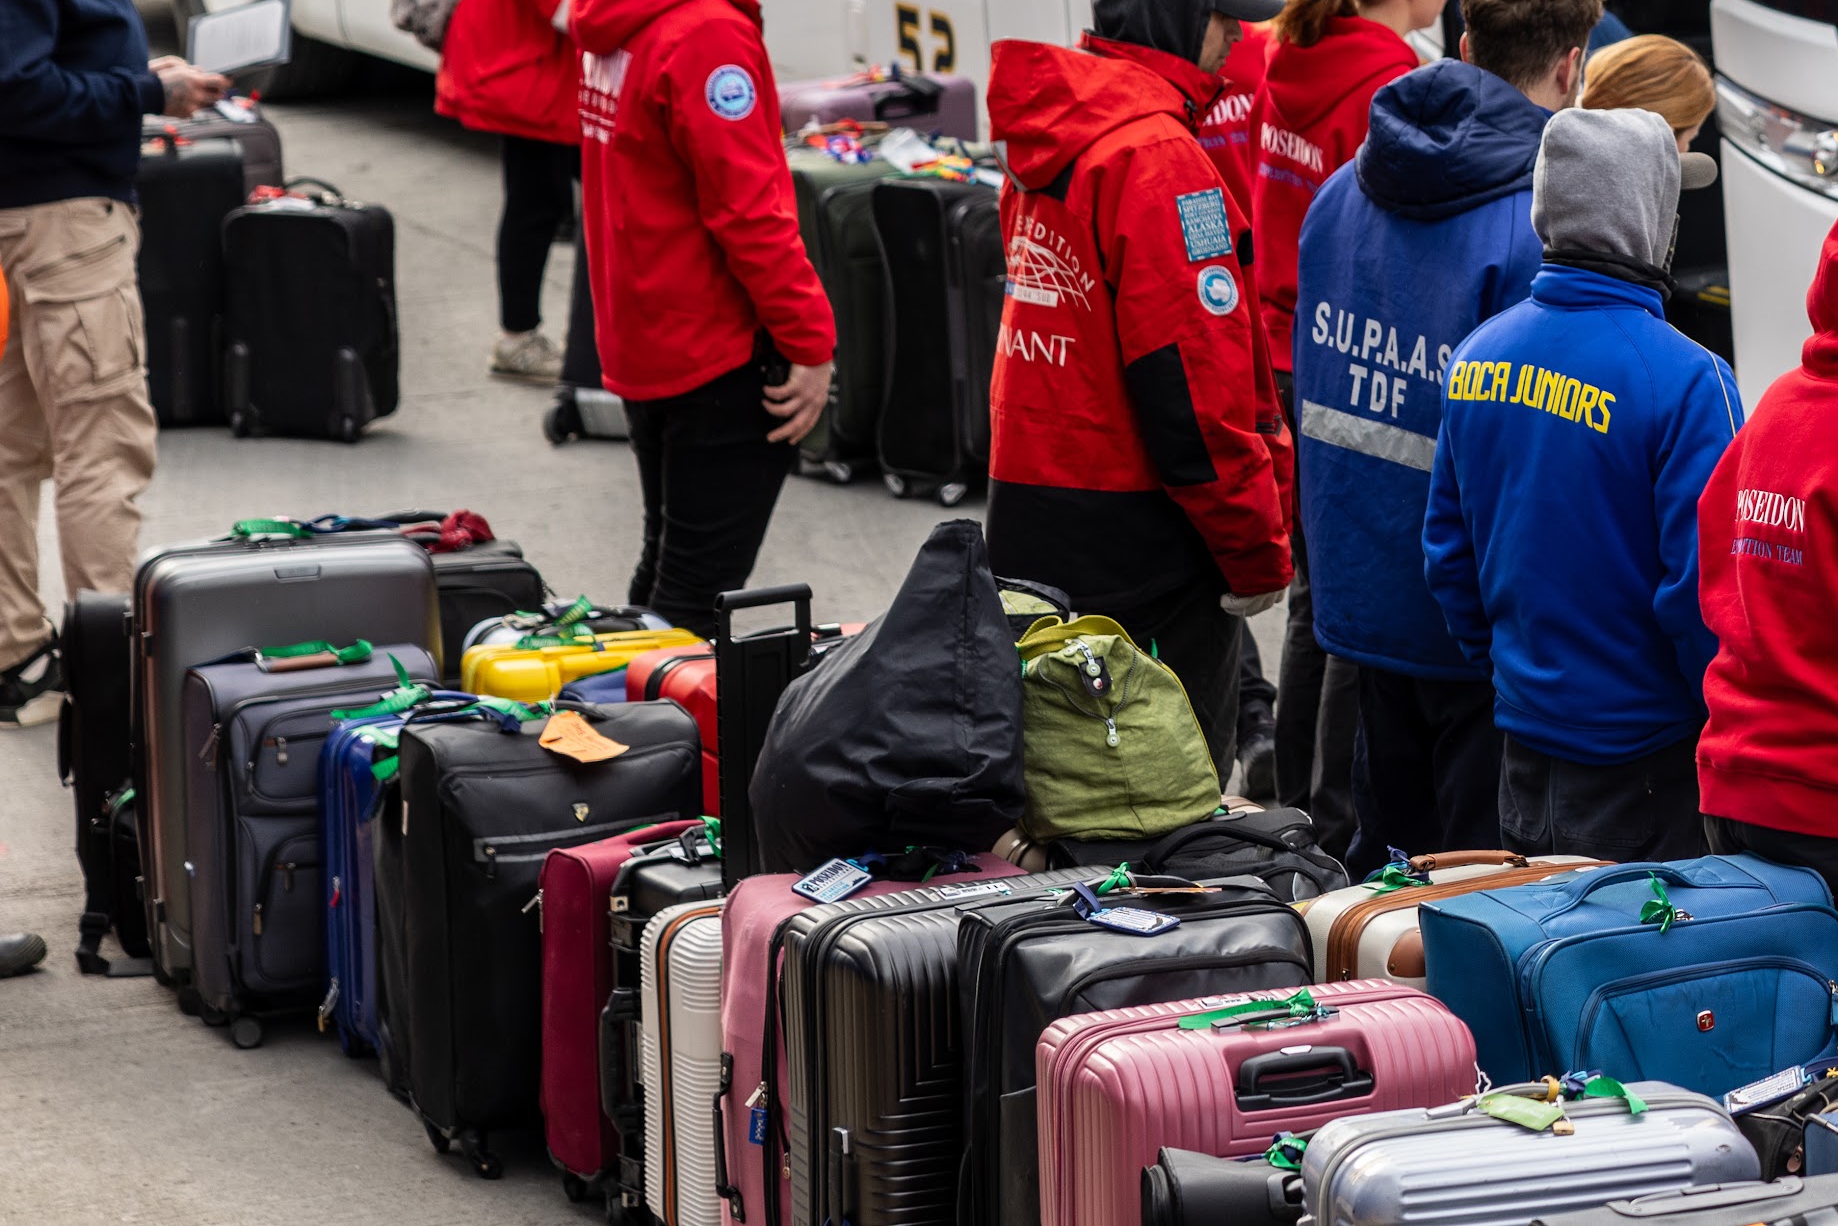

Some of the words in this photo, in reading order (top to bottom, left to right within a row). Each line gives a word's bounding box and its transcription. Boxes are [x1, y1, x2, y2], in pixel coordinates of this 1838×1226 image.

[894, 0, 956, 75] 52
[1260, 121, 1324, 174] POSEIDON
[1188, 220, 1224, 232] ALASKA
[1190, 235, 1227, 248] USHUAIA
[1349, 362, 1407, 418] TDF
[1448, 360, 1512, 402] BOCA
[1509, 363, 1617, 434] JUNIORS
[1735, 488, 1805, 533] POSEIDON
[1776, 544, 1803, 566] TEAM
[808, 860, 848, 886] POSEIDON
